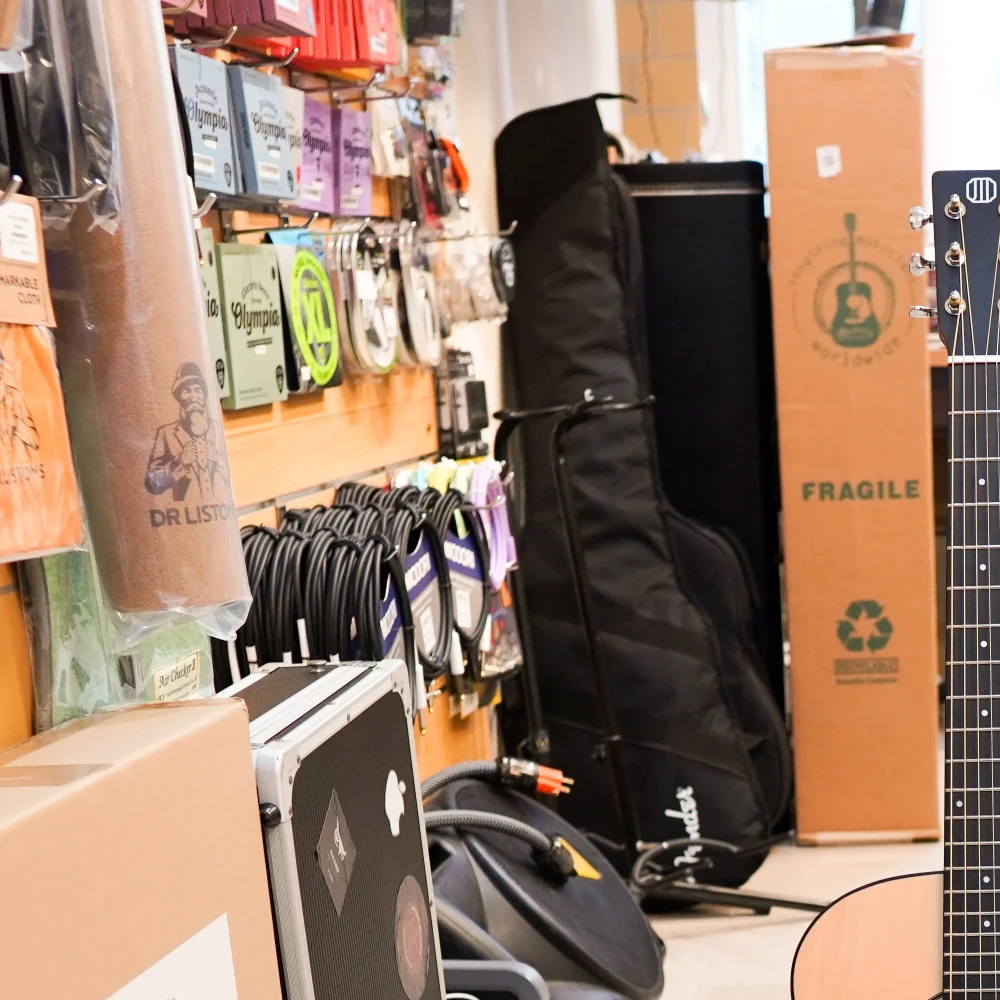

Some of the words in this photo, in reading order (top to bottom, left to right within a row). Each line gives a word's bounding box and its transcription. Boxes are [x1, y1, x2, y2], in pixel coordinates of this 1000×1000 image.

[301, 292, 332, 345] XL
[802, 480, 920, 501] FRAGILE
[150, 508, 181, 528] DR
